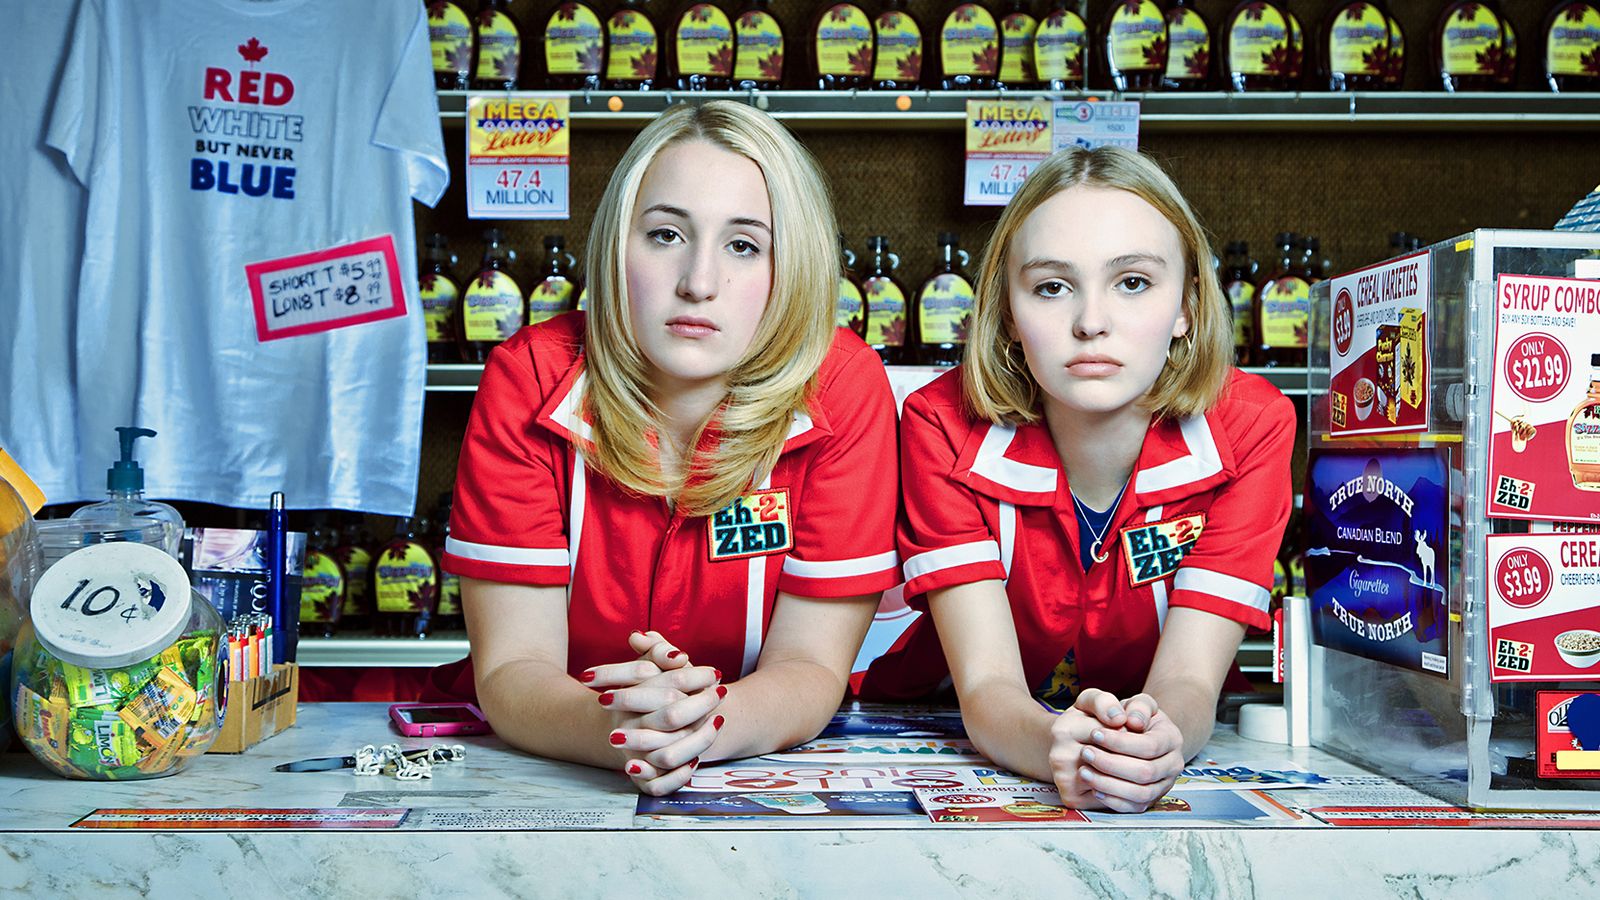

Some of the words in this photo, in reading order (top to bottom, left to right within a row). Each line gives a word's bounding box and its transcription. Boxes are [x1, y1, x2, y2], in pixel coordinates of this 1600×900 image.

[203, 67, 294, 106] RED
[485, 102, 558, 119] MEGA
[980, 105, 1044, 121] MEGA
[188, 106, 304, 142] WHITE
[195, 139, 231, 154] BUT
[236, 143, 294, 161] NEVER
[482, 128, 557, 152] Lottery
[978, 129, 1043, 148] Lottery
[190, 158, 296, 199] BLUE
[497, 170, 541, 188] 47.4
[990, 164, 1029, 181] 47.4
[486, 189, 553, 204] MILLION
[269, 268, 318, 294] SHORT
[322, 266, 334, 283] T
[1357, 272, 1379, 307] CEREAL
[1381, 262, 1418, 302] VARIETIES
[315, 288, 330, 307] T
[1503, 283, 1550, 311] SYRUP
[1521, 340, 1545, 357] ONLY
[1513, 354, 1564, 390] $22.99
[1329, 476, 1364, 512] TRUE
[1367, 475, 1414, 518] NORTH
[1497, 490, 1530, 510] ZED
[715, 522, 787, 556] ZED
[1337, 527, 1374, 543] CANADIAN
[1375, 527, 1402, 545] BLEND
[1507, 554, 1529, 570] ONLY
[1560, 541, 1600, 568] CERE
[1349, 569, 1390, 598] Cigarettes
[1503, 566, 1542, 599] $3.99
[1331, 597, 1365, 638] TRUE
[1368, 612, 1414, 642] NORTH
[1497, 654, 1530, 671] ZED
